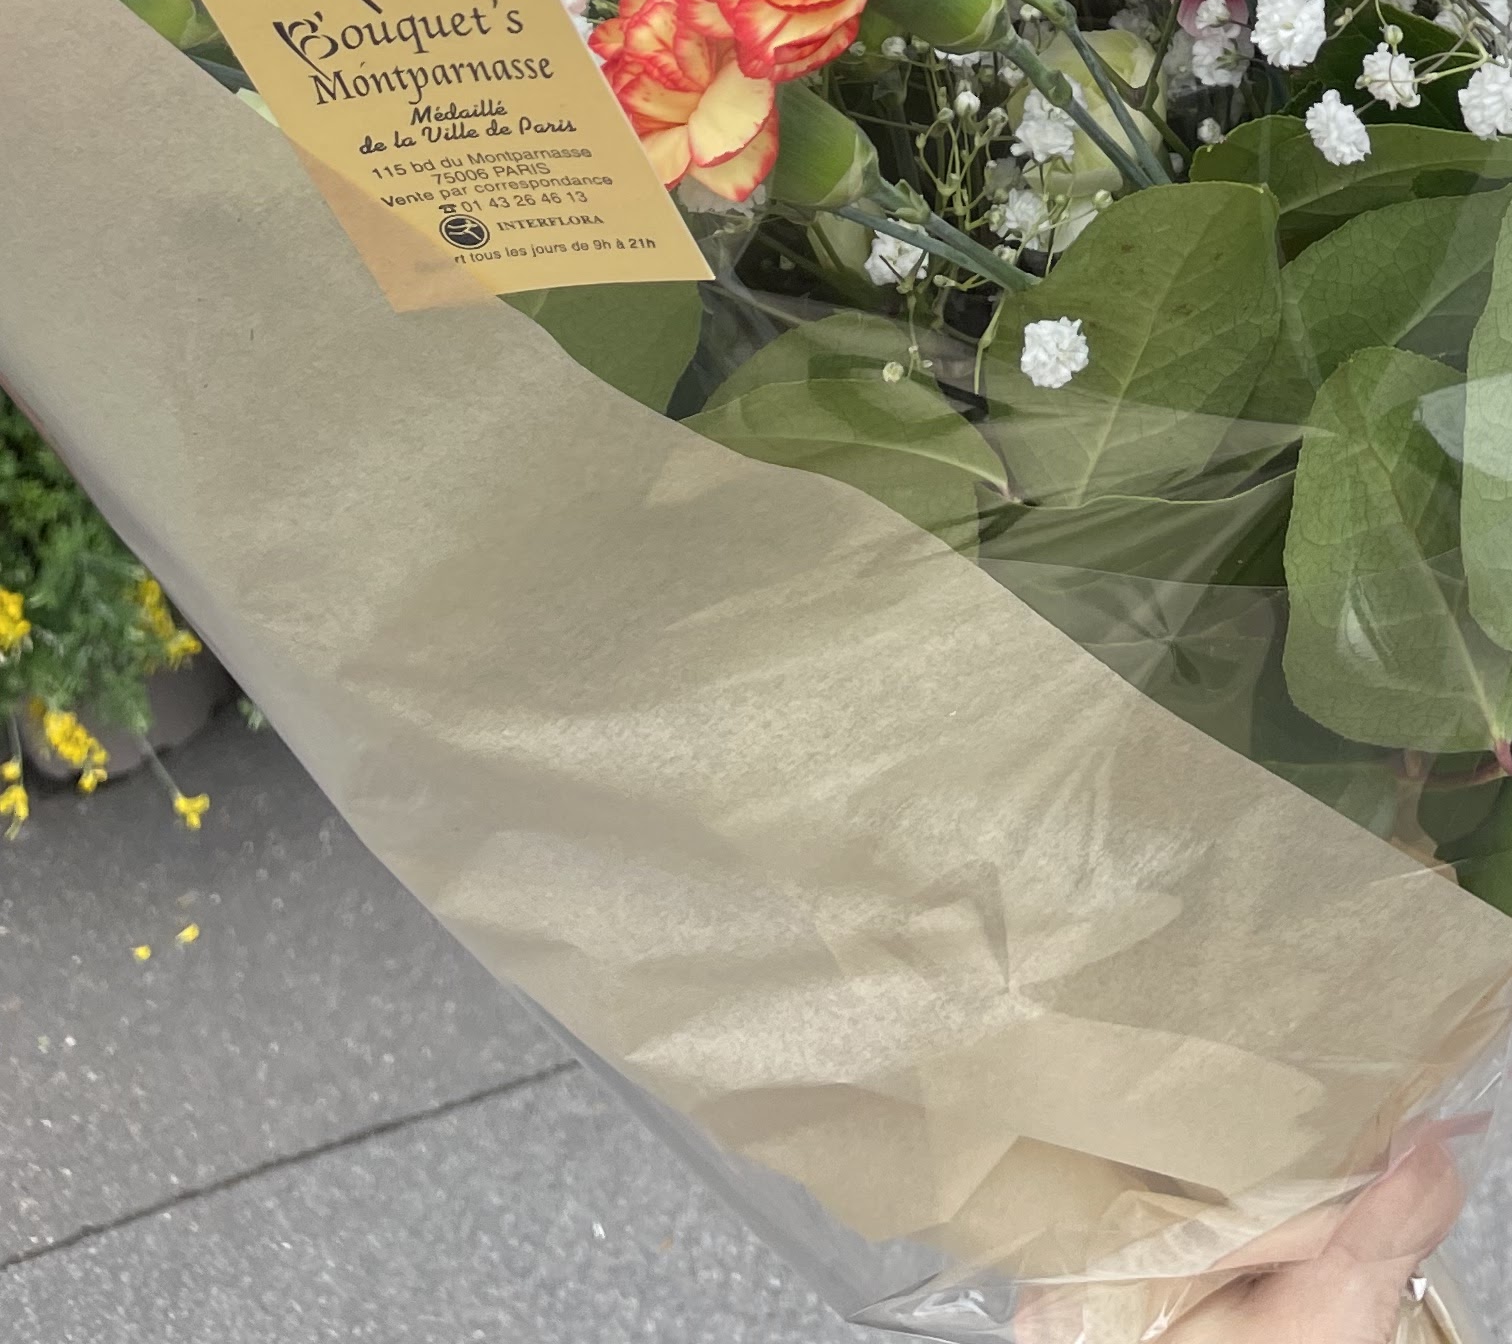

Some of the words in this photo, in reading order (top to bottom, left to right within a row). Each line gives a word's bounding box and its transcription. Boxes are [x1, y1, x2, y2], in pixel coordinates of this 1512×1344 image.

[410, 99, 508, 126] Médaillé
[359, 135, 388, 155] de
[394, 130, 418, 149] la
[421, 122, 480, 144] Ville
[486, 118, 513, 137] de
[518, 116, 578, 135] Paris
[372, 164, 407, 180] 115
[410, 159, 436, 174] bd
[440, 155, 464, 169] du
[466, 146, 593, 166] Montparnasse
[431, 168, 490, 186] 75006
[493, 162, 552, 178] PARIS
[381, 189, 435, 208] Vente
[440, 186, 468, 201] par
[474, 175, 613, 196] correspondance
[461, 199, 483, 213] 01
[489, 196, 511, 210] 43
[515, 193, 537, 207] 26
[541, 192, 562, 205] 46
[568, 190, 588, 204] 13
[496, 214, 605, 232] INTERFLORA
[470, 249, 502, 263] tous
[505, 245, 528, 259] les
[531, 242, 568, 259] jours
[571, 239, 590, 252] de
[592, 238, 612, 252] 9h
[628, 237, 657, 250] 21h
